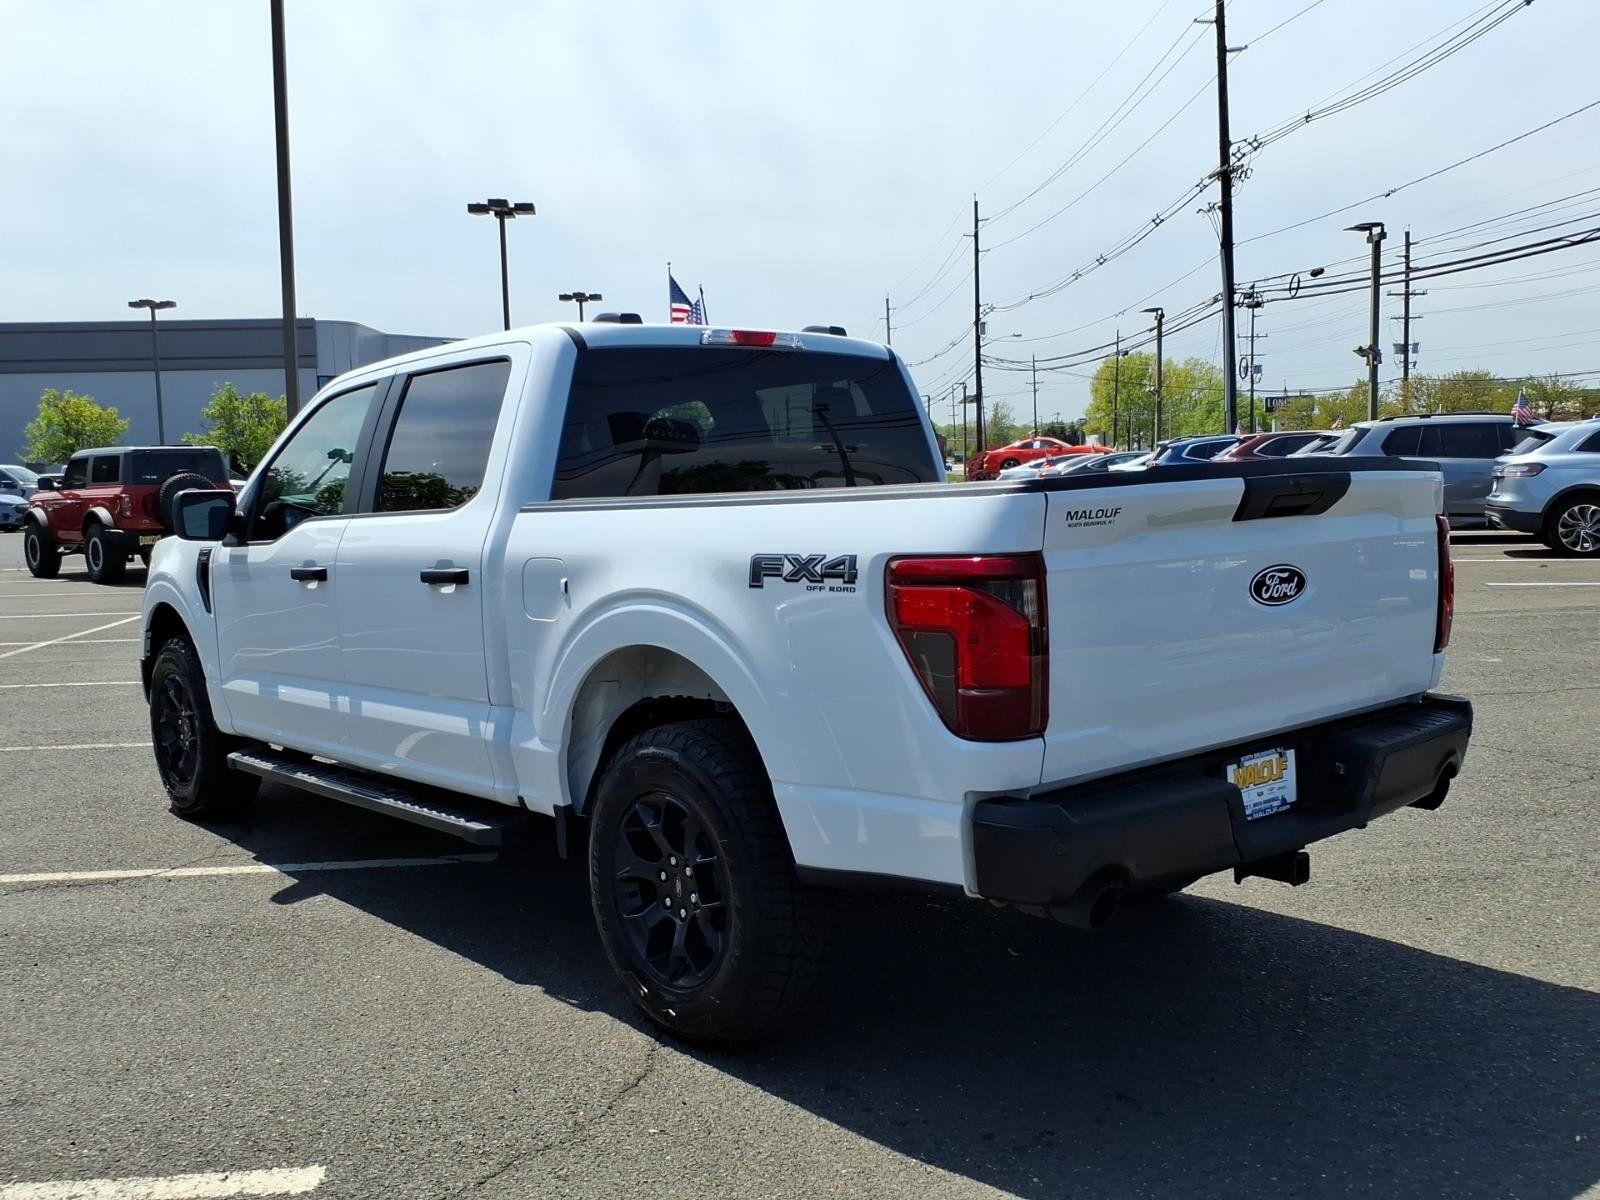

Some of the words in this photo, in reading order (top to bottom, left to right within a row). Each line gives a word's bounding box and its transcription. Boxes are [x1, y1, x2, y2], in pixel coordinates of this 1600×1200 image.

[1066, 507, 1122, 521] MALOUF
[749, 553, 858, 589] FX4
[1261, 571, 1298, 599] Ford
[829, 585, 856, 593] ROAD
[1233, 757, 1288, 789] MALOUF
